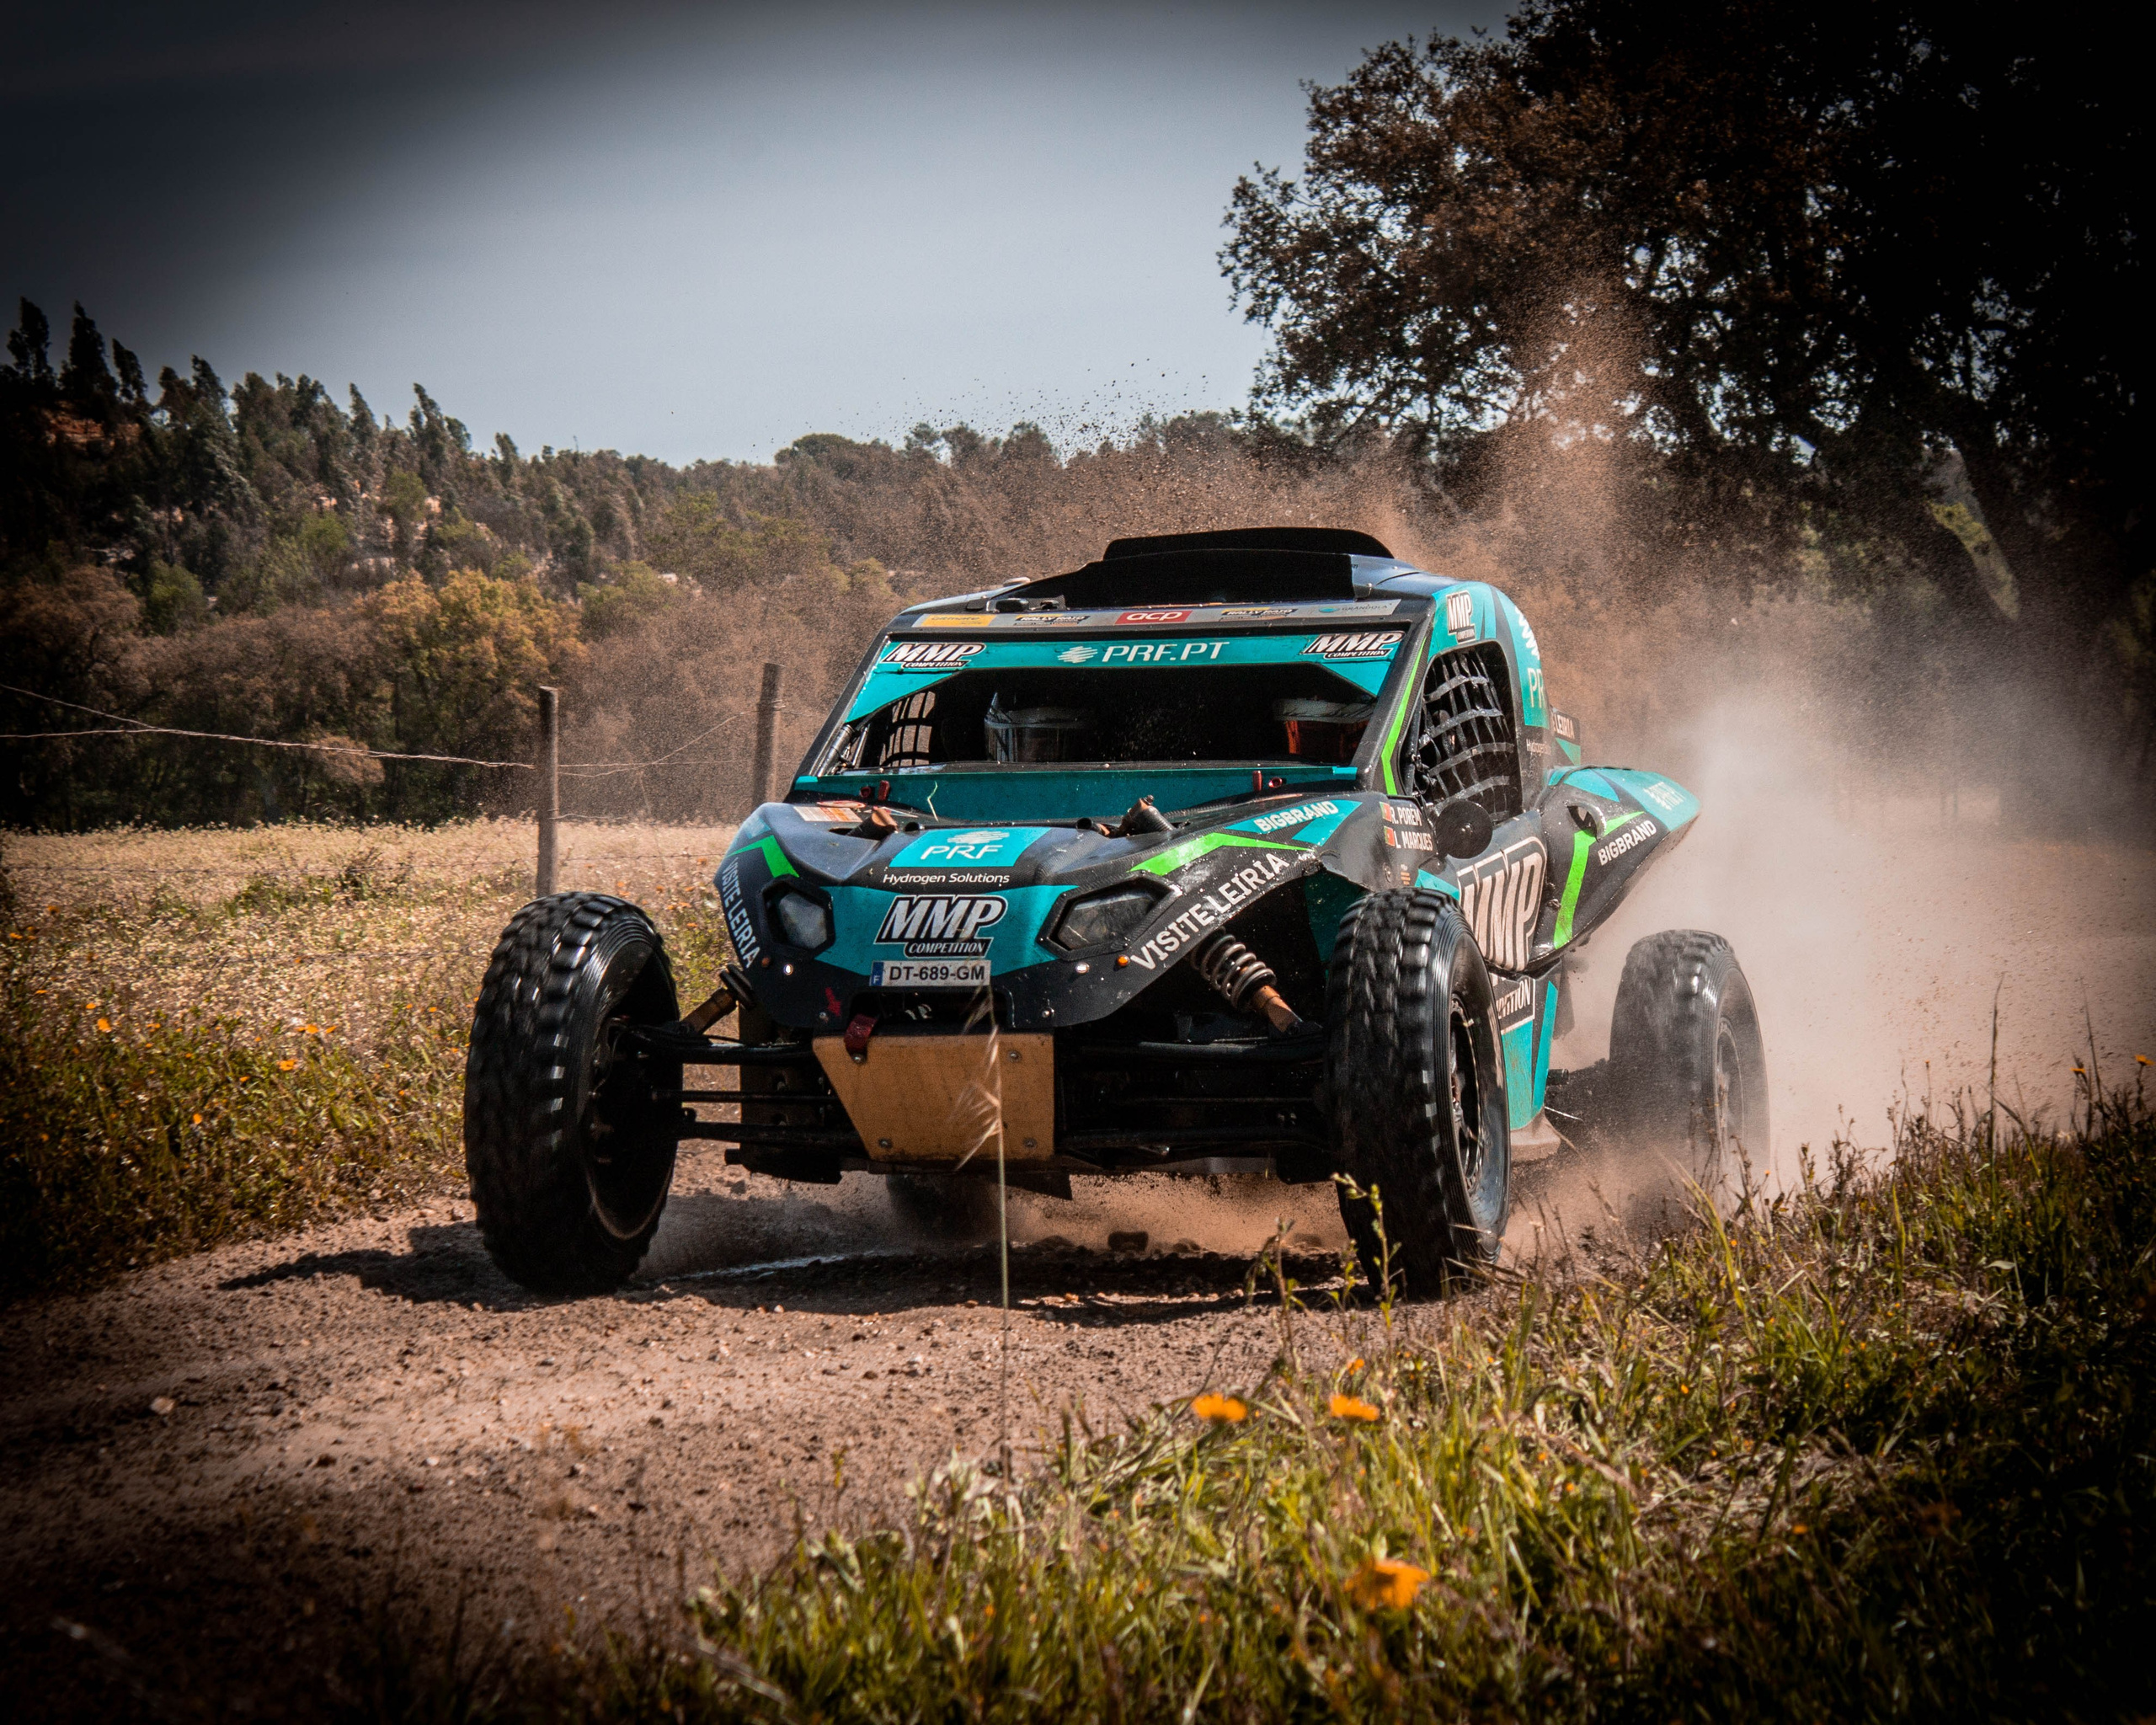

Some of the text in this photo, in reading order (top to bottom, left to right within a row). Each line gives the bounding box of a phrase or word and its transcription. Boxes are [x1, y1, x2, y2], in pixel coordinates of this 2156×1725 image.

[1127, 611, 1183, 622] acp
[1448, 593, 1472, 631] MMP
[887, 644, 985, 662] MMP
[1102, 642, 1230, 663] PRF.PT
[1308, 632, 1404, 653] MMP
[1328, 649, 1387, 659] COMPETITION
[1252, 799, 1339, 833] BIGBRAND
[1401, 830, 1433, 852] MARQUES
[1598, 820, 1657, 867] BIGBRAND
[920, 845, 1003, 860] PRF
[883, 873, 1010, 885] Hydrogen Solutions
[722, 857, 760, 969] VISITE LEIRIA
[881, 900, 1002, 939] MMP
[1130, 852, 1290, 970] VISITE LEIRIA
[909, 942, 986, 953] COMPETITION
[873, 965, 985, 984] F DT-689-GM
